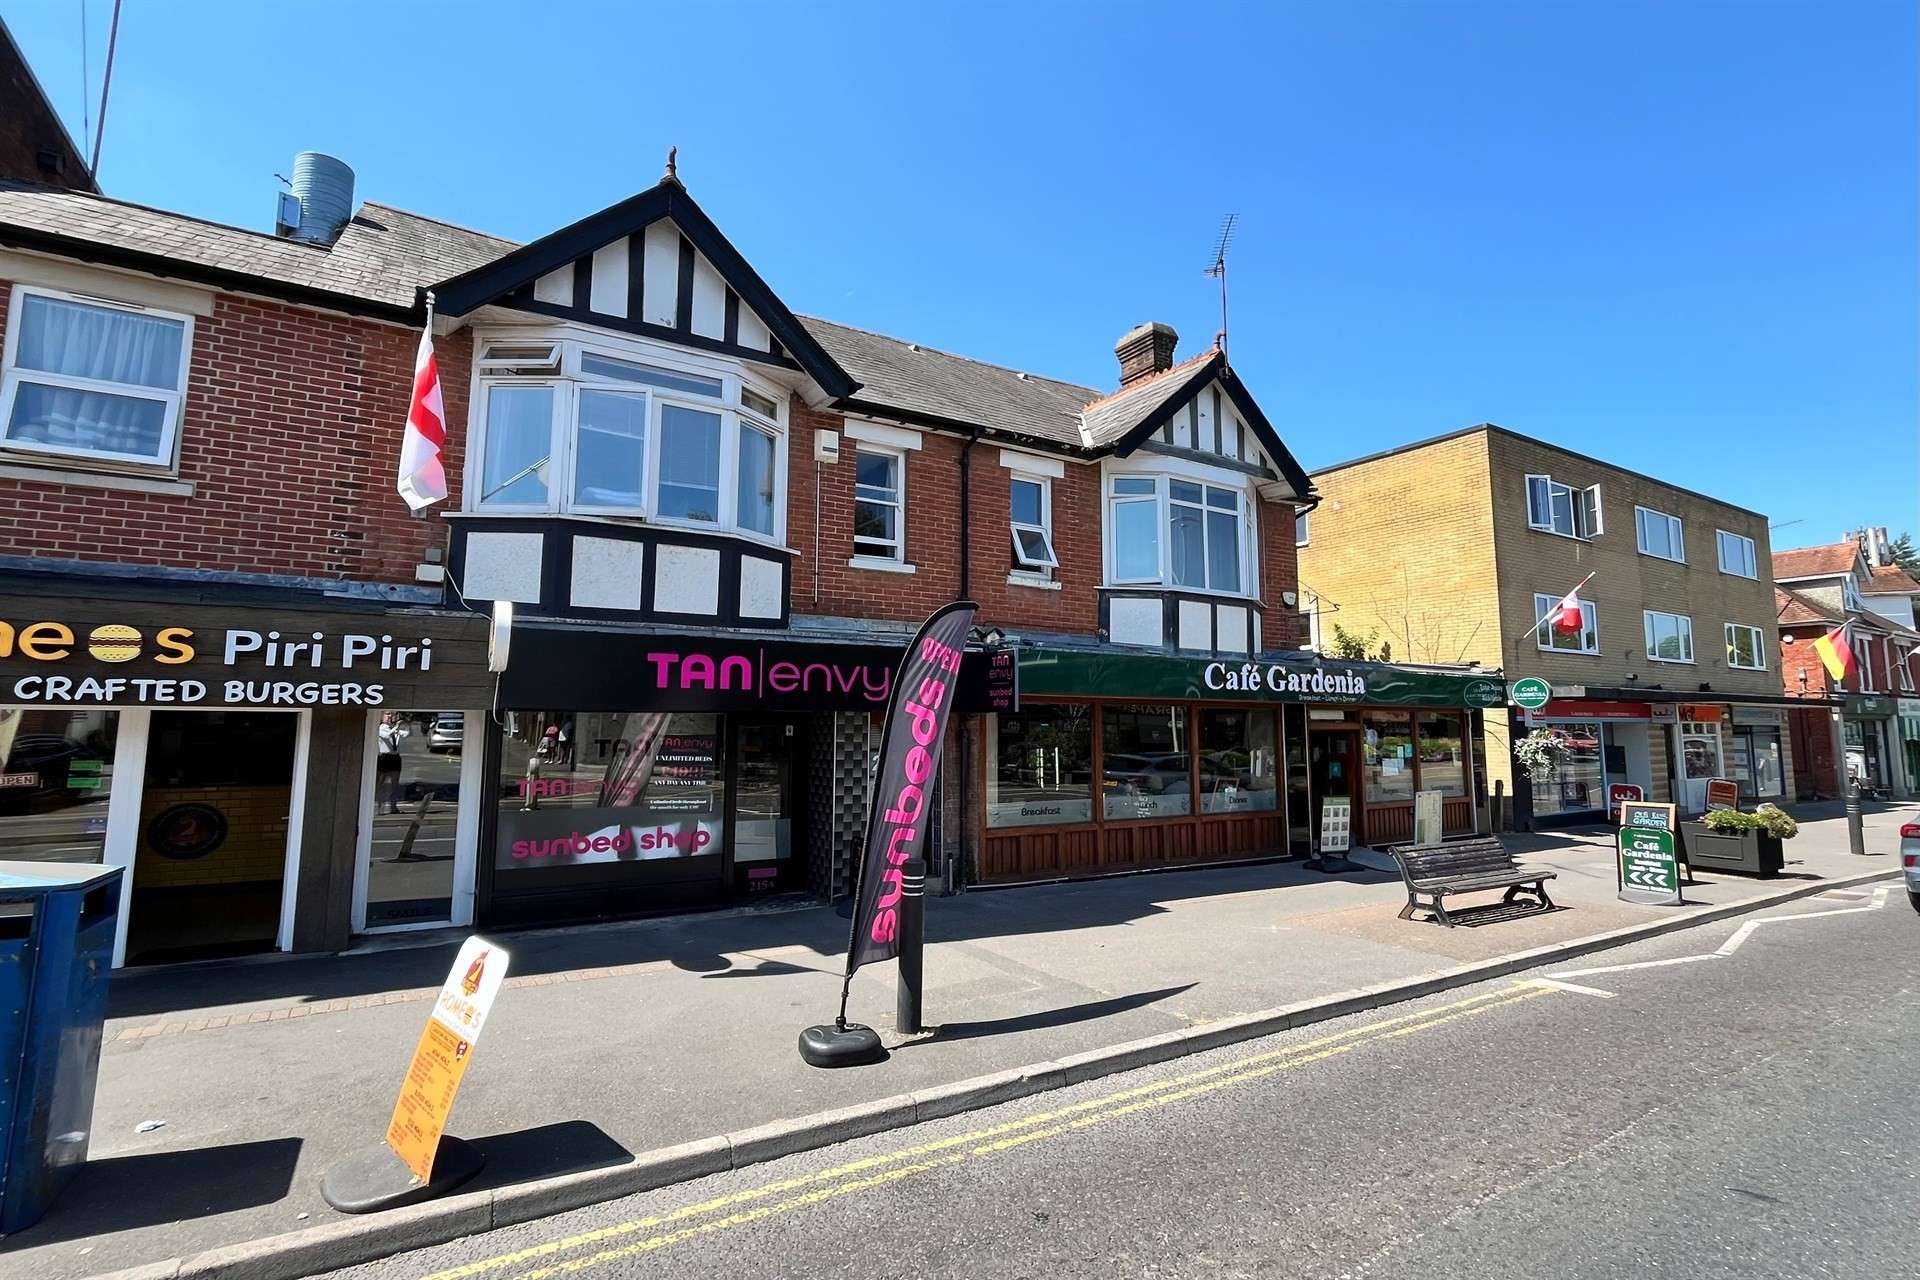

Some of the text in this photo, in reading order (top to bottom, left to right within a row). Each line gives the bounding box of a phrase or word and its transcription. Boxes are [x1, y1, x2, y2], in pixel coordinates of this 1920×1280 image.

[224, 630, 324, 667] Piri
[342, 634, 432, 671] Piri
[991, 654, 1009, 667] TAN
[13, 675, 385, 705] CRAFTED BURGERS
[648, 652, 889, 701] TAN envy
[1204, 662, 1366, 695] Café Gardenia
[871, 676, 945, 943] sunbeds
[1021, 807, 1062, 817] Breakfast
[511, 825, 711, 860] sunbed shop
[1622, 848, 1673, 861] Gardenia
[1633, 840, 1660, 851] Café
